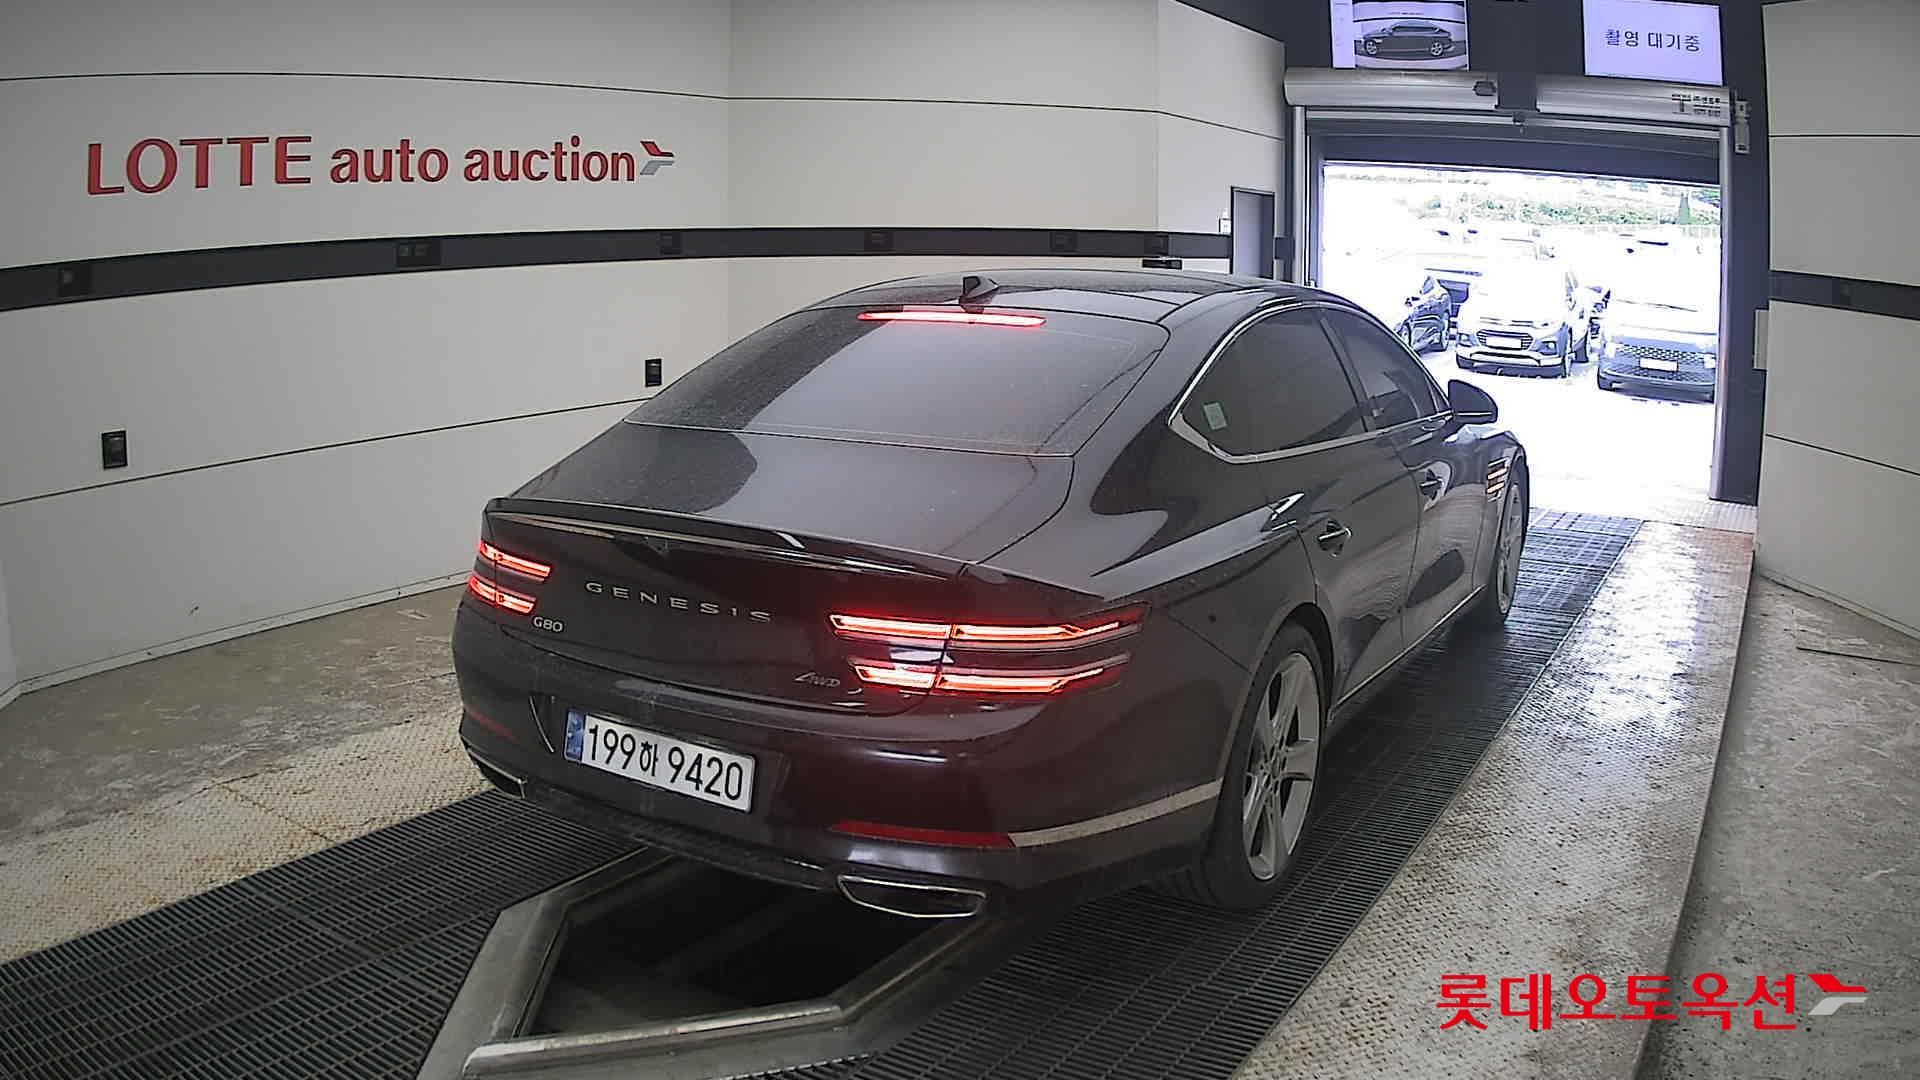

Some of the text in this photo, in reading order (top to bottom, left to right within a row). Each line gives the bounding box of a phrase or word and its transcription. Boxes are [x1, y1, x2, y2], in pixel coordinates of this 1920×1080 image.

[1648, 32, 1699, 51] 대기중
[88, 136, 635, 195] LOTTE auto auction
[585, 582, 771, 623] GENESIS
[533, 616, 563, 632] G80
[589, 724, 743, 801] 199하 9420
